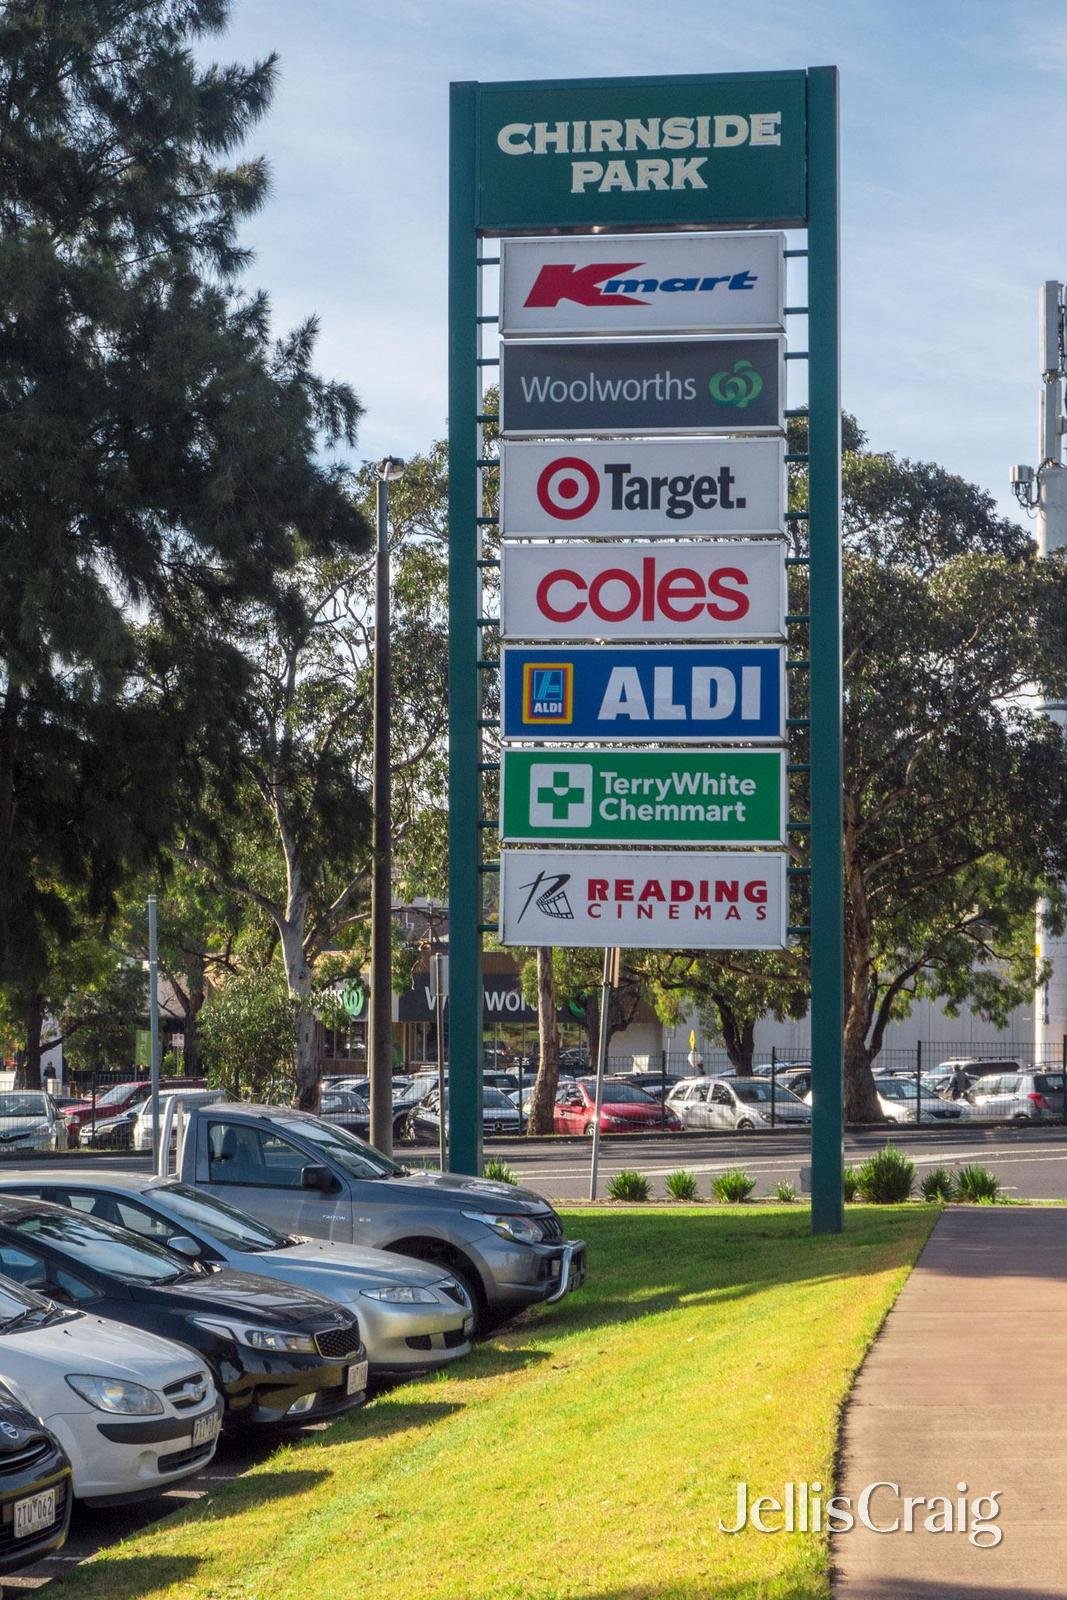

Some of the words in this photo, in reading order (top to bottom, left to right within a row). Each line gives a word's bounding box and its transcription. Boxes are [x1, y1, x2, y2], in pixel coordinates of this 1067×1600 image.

[497, 111, 782, 156] CHIRNSIDE
[571, 157, 708, 193] PARK
[523, 262, 758, 308] Kmart
[520, 370, 697, 403] Woolworths
[604, 463, 746, 520] Target.
[536, 557, 750, 623] coles
[533, 702, 563, 714] ALDI
[597, 666, 761, 721] ALDI
[600, 771, 757, 801] TerryWhite
[599, 798, 746, 823] Chemmart
[587, 878, 768, 903] READING
[587, 903, 767, 920] CINEMAS
